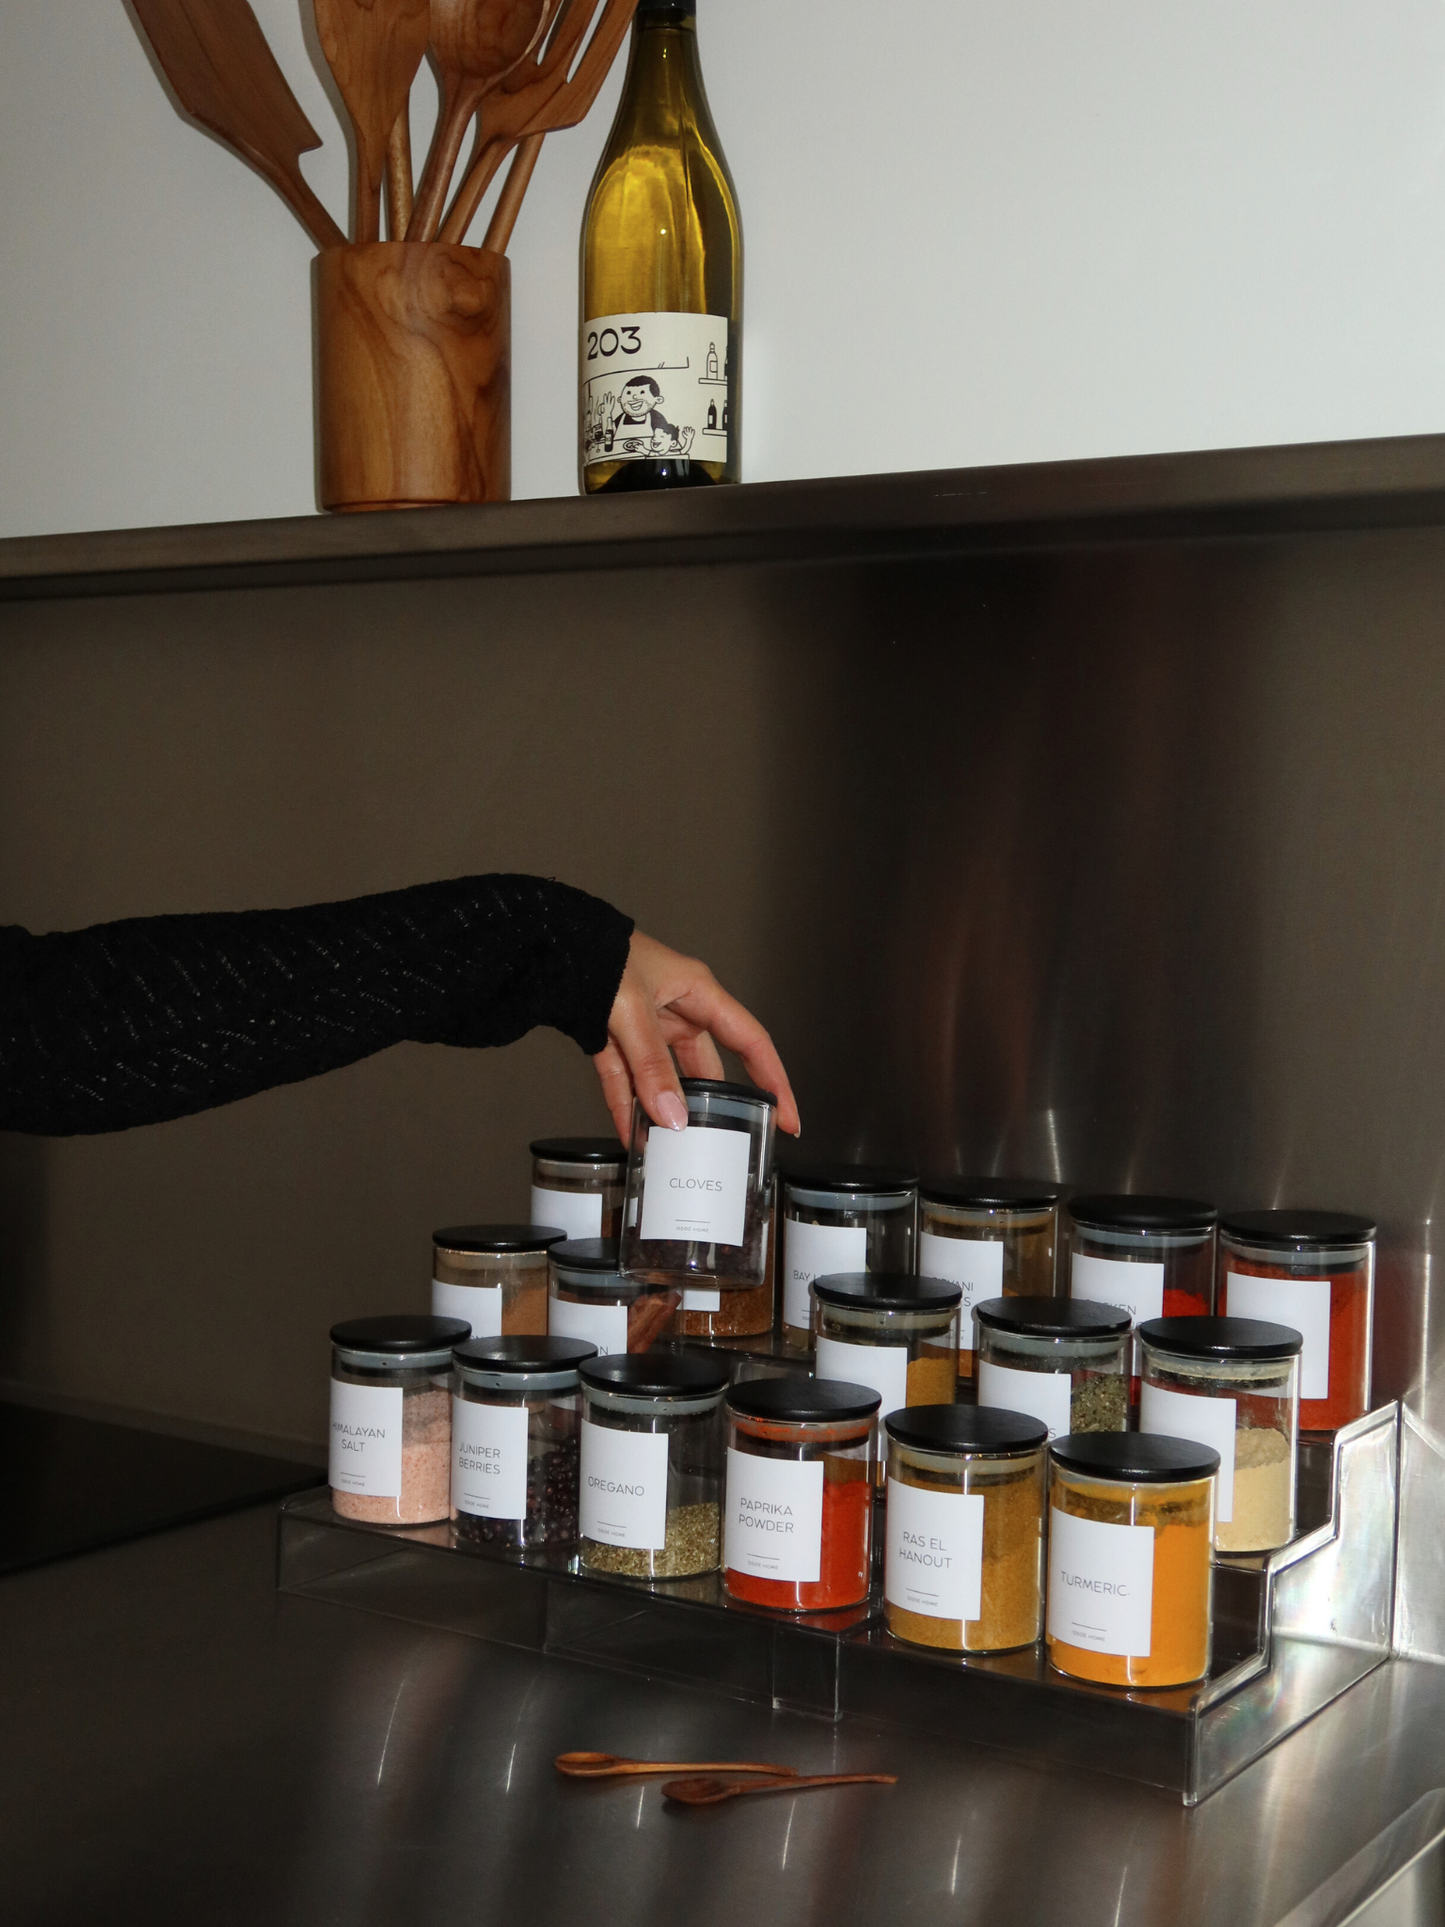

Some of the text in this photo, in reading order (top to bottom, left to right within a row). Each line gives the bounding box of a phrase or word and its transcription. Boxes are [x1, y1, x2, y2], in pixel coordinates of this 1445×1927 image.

[588, 326, 641, 361] 203
[669, 1178, 723, 1192] CLOVES
[793, 1269, 811, 1281] BAY
[332, 1422, 386, 1439] HIMALAYAN
[341, 1439, 365, 1452] SALT
[459, 1442, 501, 1459] JUNIPER
[458, 1457, 501, 1475] BERRIES
[588, 1476, 645, 1496] OREGANO
[740, 1497, 793, 1516] PAPRIKA
[738, 1514, 794, 1533] POWDER
[903, 1531, 947, 1551] RAS EL
[899, 1547, 952, 1569] HANOUT
[921, 1599, 938, 1607] HOME
